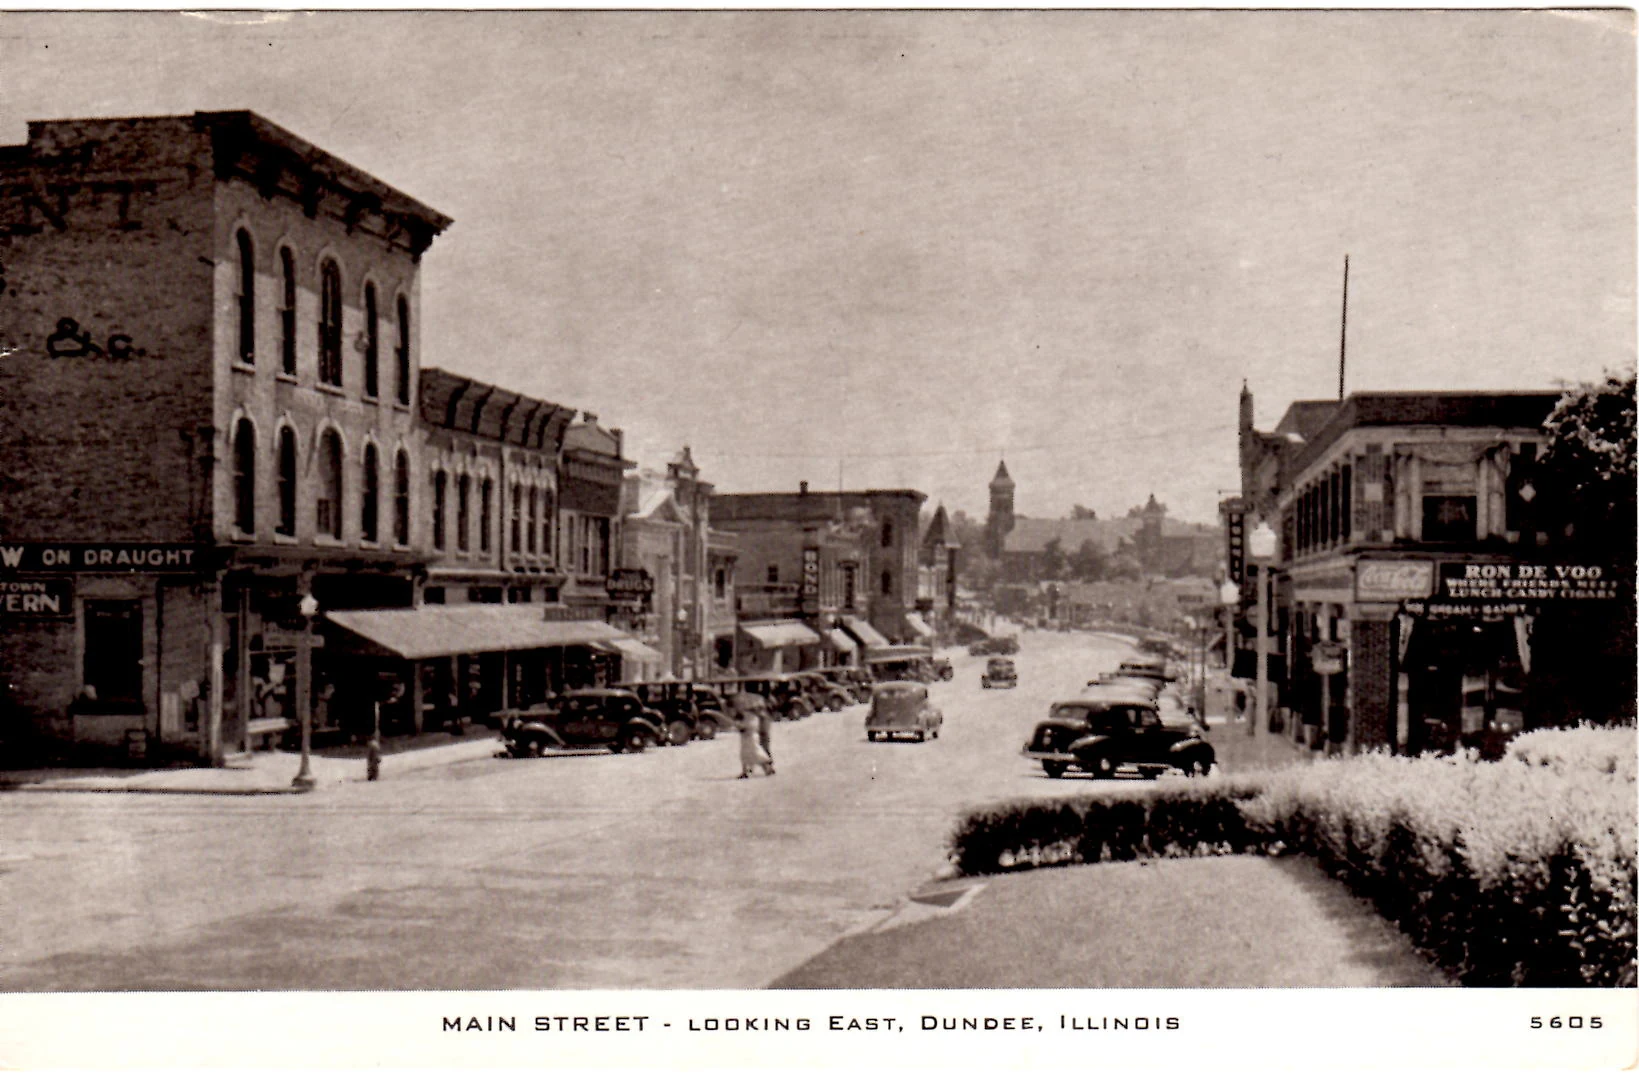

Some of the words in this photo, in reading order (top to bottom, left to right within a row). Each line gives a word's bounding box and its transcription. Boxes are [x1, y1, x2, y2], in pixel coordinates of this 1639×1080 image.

[42, 549, 71, 566] ON
[84, 549, 195, 566] DRAUGHT
[1465, 565, 1512, 579] RON
[1518, 565, 1548, 579] DE
[1555, 565, 1602, 579] VOO
[606, 578, 652, 591] DRUGS
[1446, 578, 1498, 589] WHERE
[1503, 580, 1572, 589] FRIENDS
[1560, 589, 1618, 598] CIGARS
